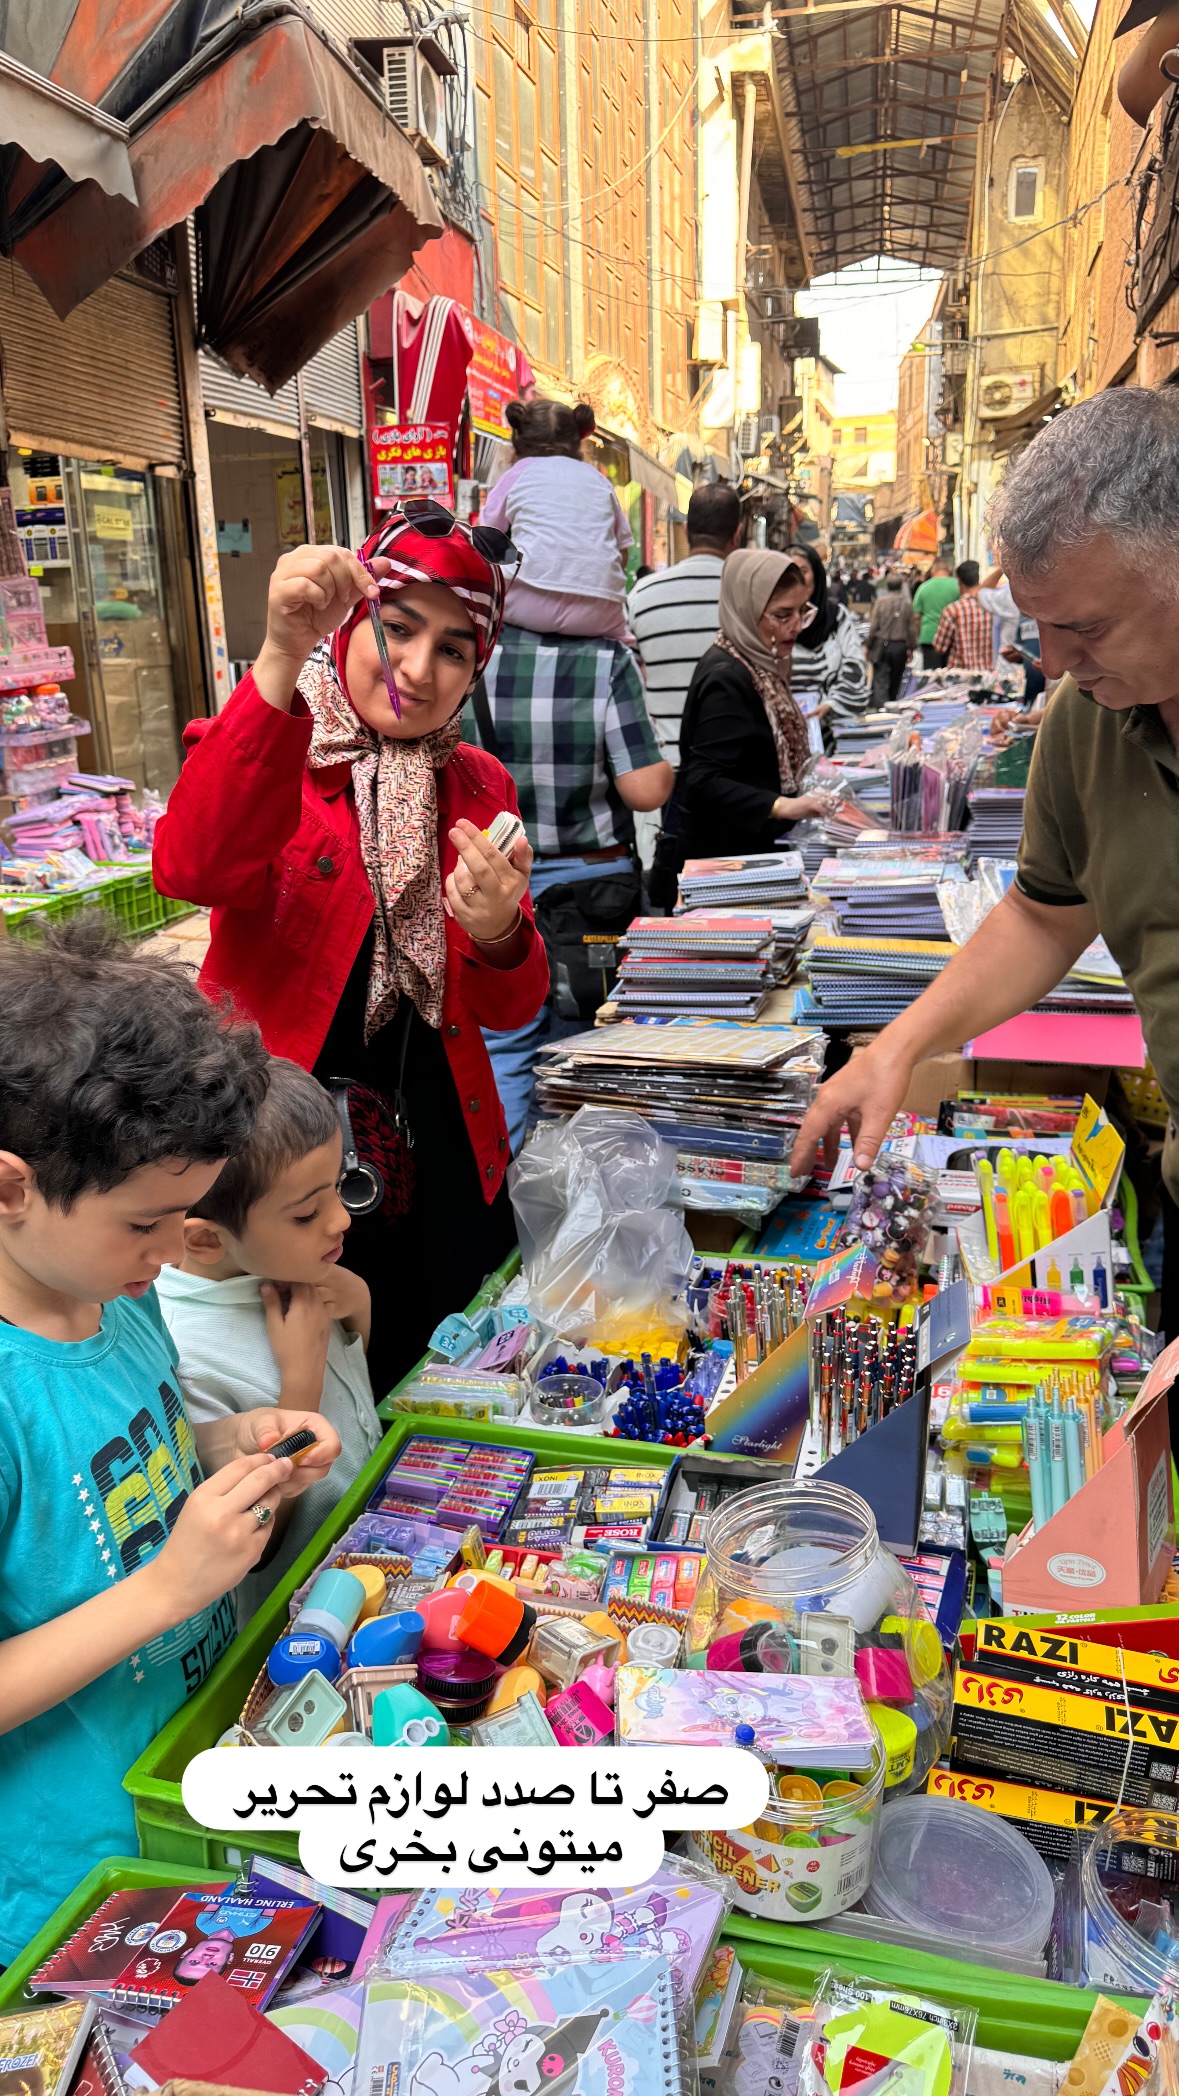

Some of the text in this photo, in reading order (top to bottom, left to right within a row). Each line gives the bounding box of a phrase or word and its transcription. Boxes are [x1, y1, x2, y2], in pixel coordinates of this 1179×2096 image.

[731, 1434, 783, 1452] Starlight
[603, 1528, 640, 1537] ROSE
[1056, 1612, 1097, 1621] 12 COLOR
[983, 1623, 1079, 1665] RAZI
[962, 1676, 1024, 1706] رازی
[1104, 1705, 1179, 1744] AZI
[697, 1838, 780, 1893] HARPENER
[200, 1894, 295, 1909] ERLING HAALAND
[248, 1945, 278, 1958] 90
[242, 1957, 272, 1965] OVERALL
[855, 1990, 869, 2001] 100
